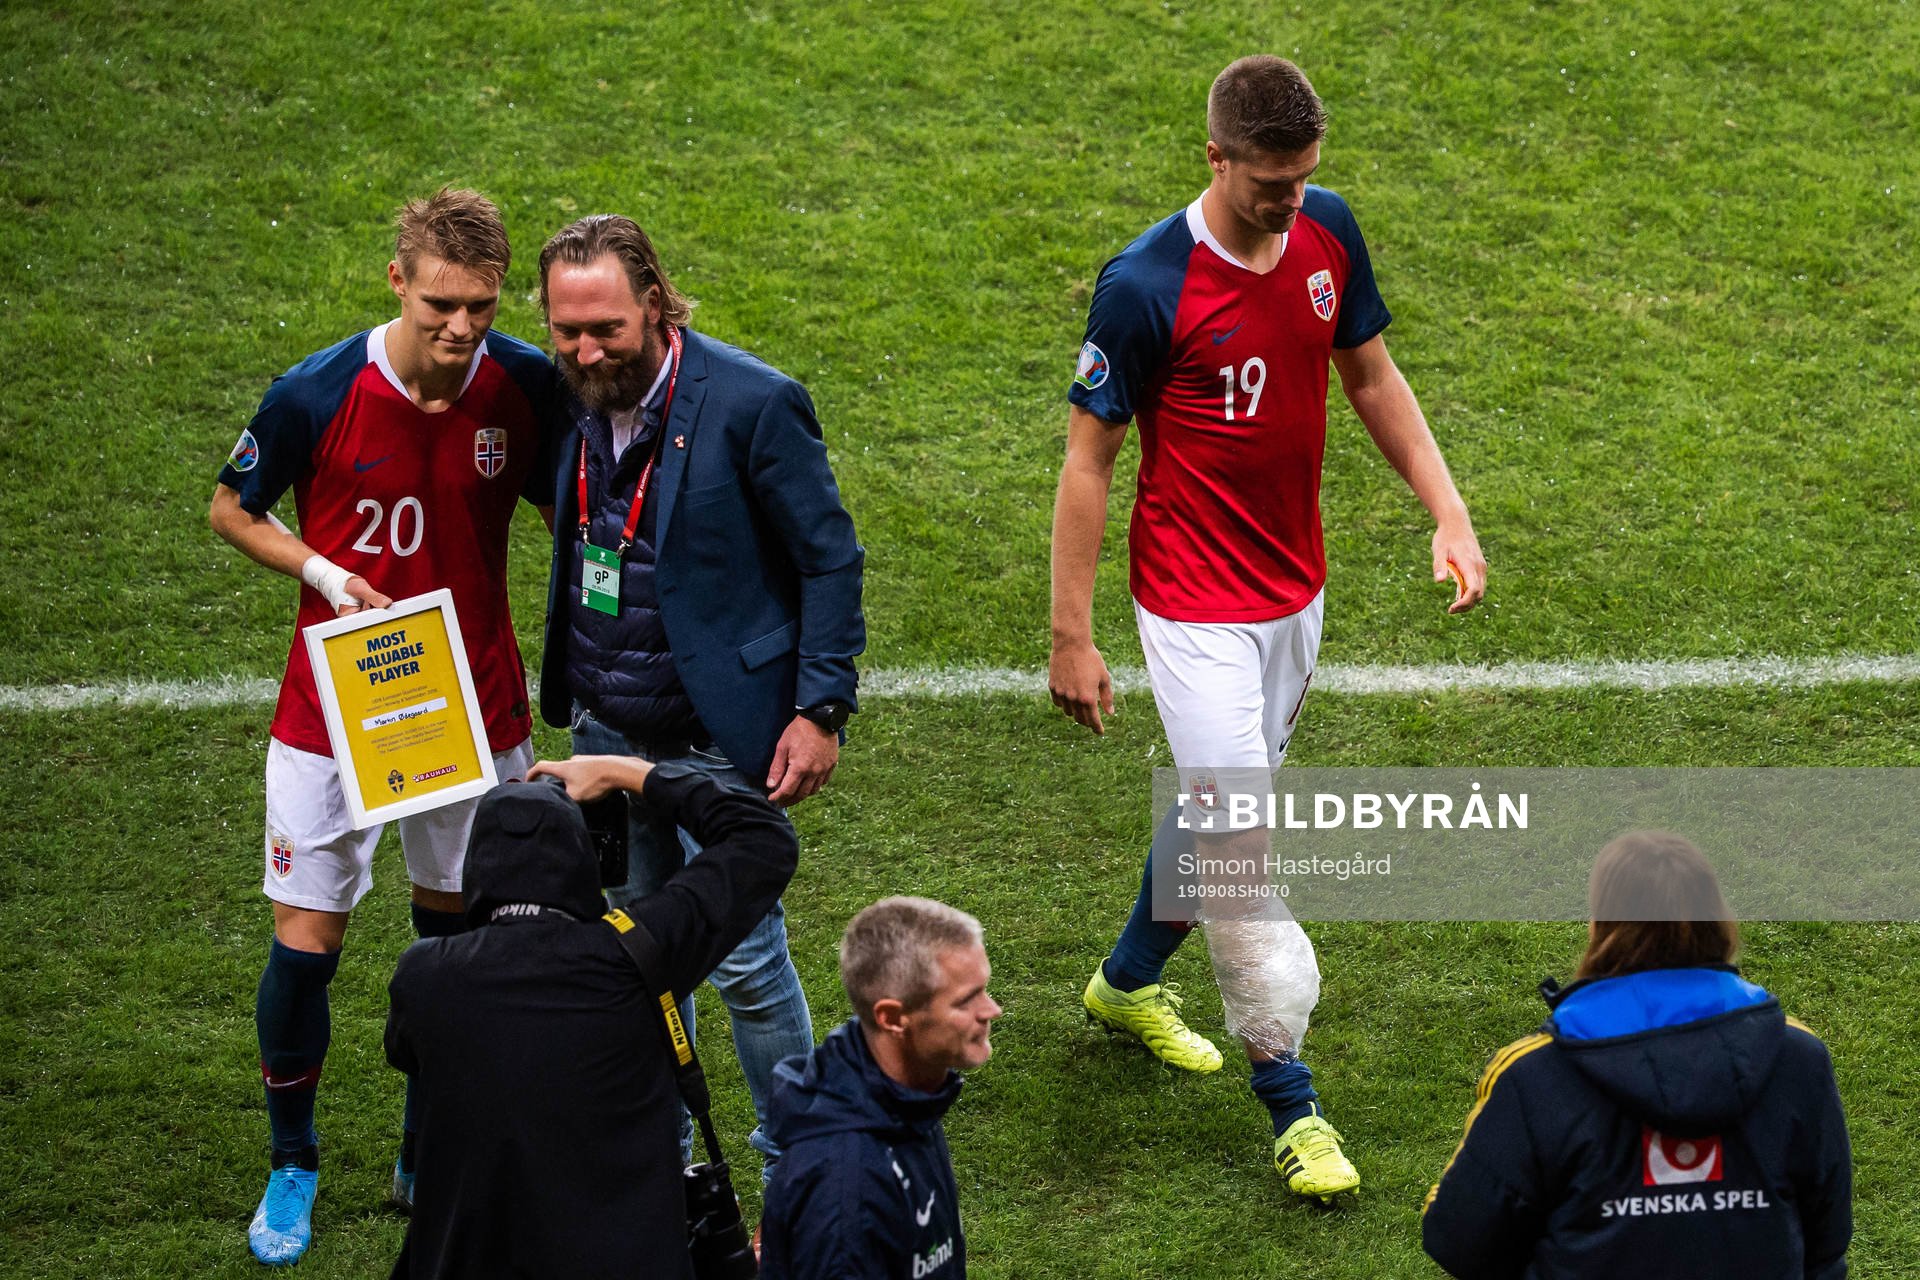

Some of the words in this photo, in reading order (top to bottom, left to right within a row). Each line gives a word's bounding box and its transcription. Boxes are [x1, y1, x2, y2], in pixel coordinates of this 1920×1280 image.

[1219, 357, 1267, 421] 19
[352, 496, 424, 557] 20
[366, 630, 406, 653] MOST
[356, 642, 424, 672] VALUABLE
[369, 661, 420, 686] PLAYER
[419, 765, 457, 781] BAUHAUS
[669, 1010, 685, 1046] Nikon
[1601, 1192, 1707, 1218] SVENSKA
[1713, 1190, 1770, 1211] SPEL
